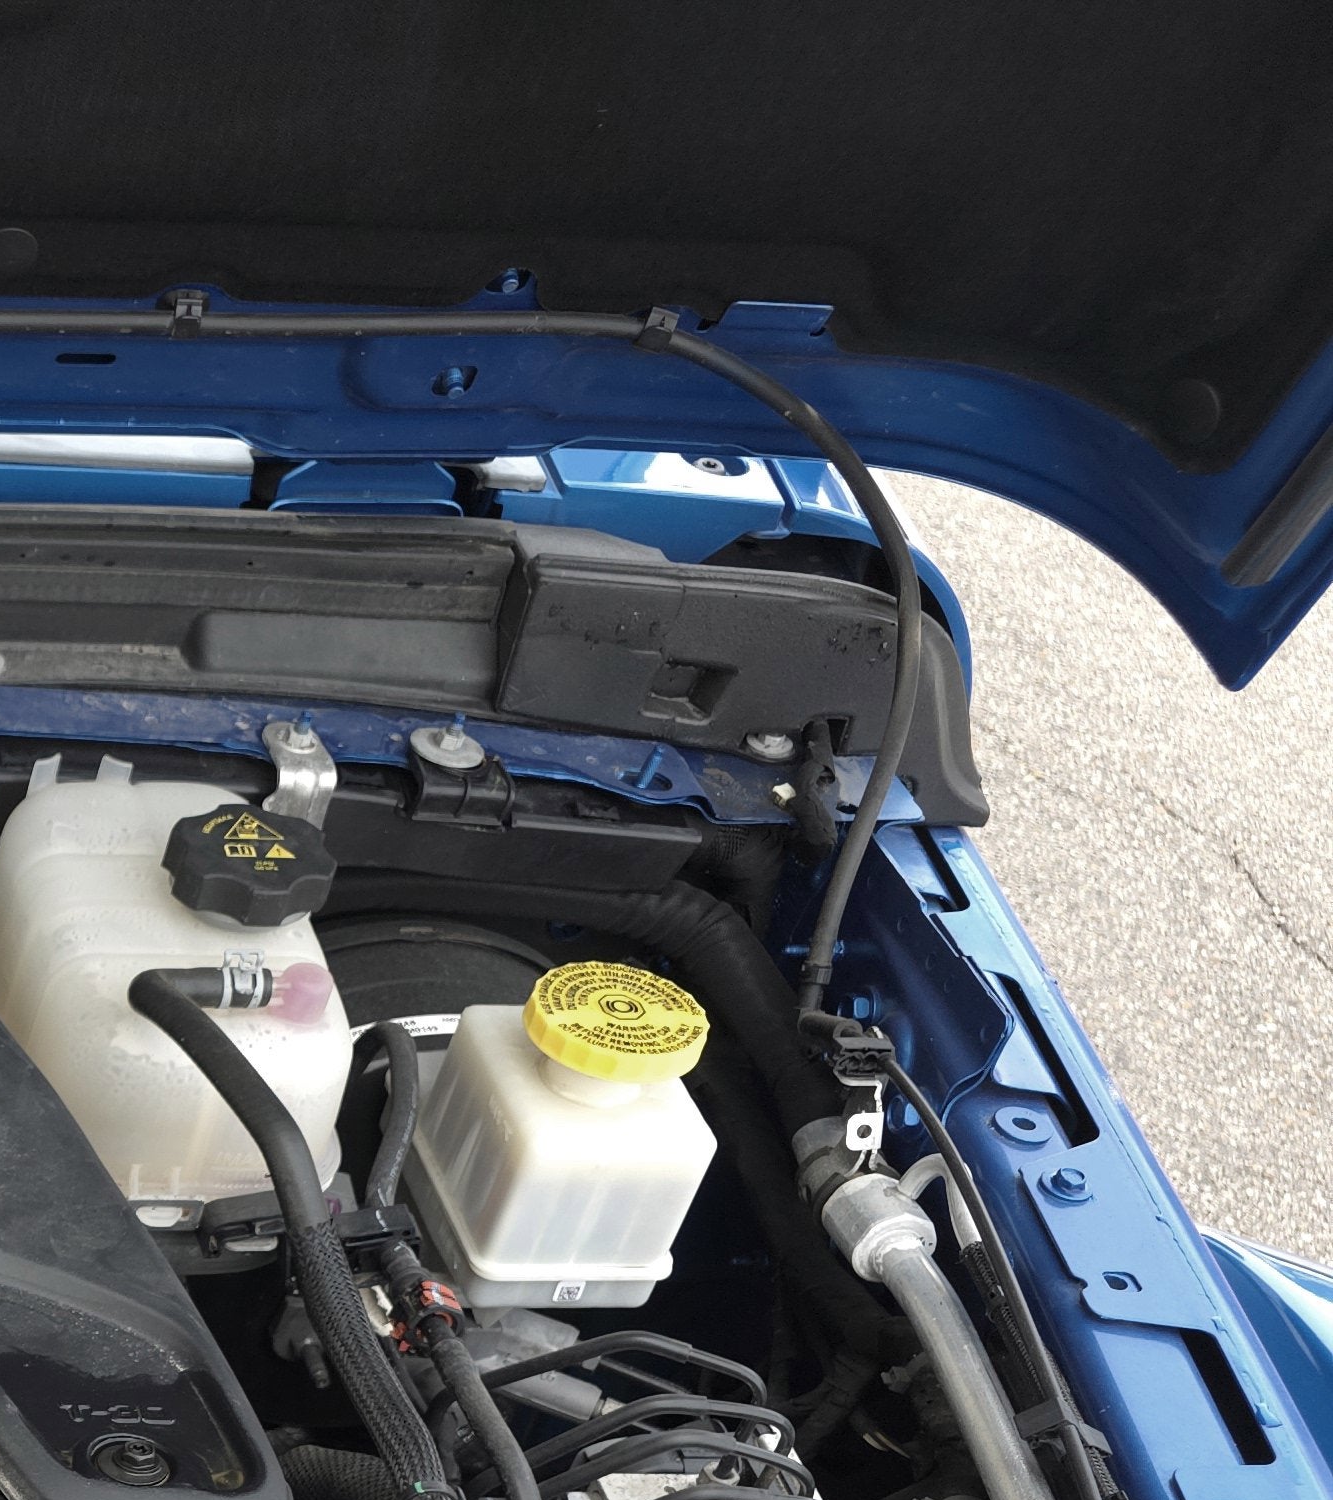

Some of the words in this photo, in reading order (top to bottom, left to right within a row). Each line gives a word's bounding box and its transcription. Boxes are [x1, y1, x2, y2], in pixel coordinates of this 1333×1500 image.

[571, 1022, 607, 1041] BEFORE
[593, 1025, 627, 1038] CLEAN
[627, 1032, 657, 1041] FILLER
[607, 1022, 655, 1032] WARNING
[583, 1037, 608, 1048] FLUID
[609, 1045, 637, 1054] FROM
